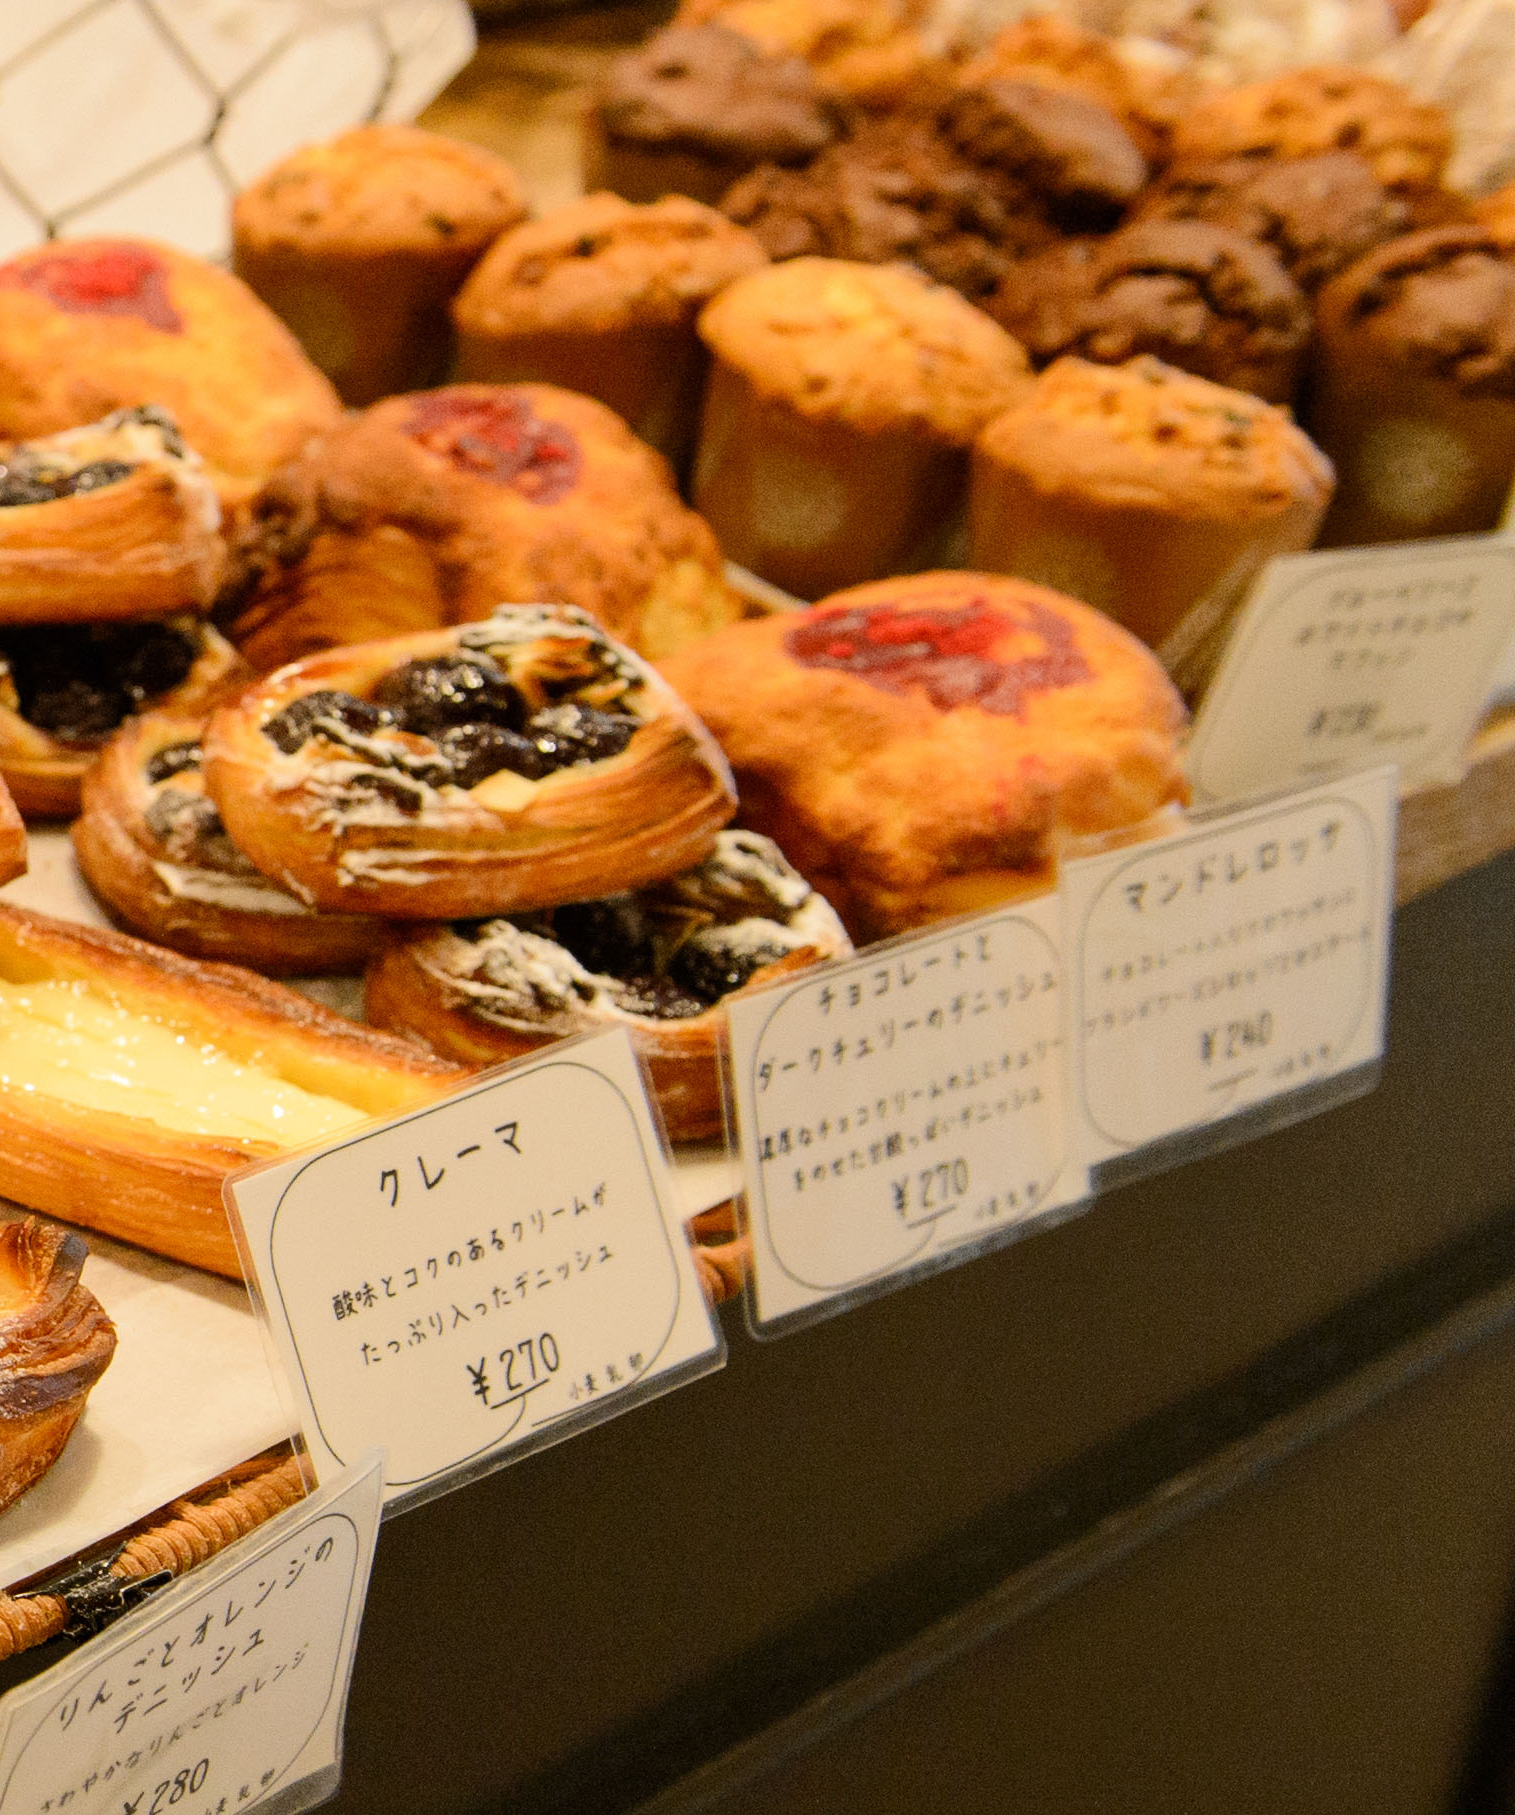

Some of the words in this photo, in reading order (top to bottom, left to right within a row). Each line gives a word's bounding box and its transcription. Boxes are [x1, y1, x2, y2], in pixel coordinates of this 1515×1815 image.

[818, 936, 989, 1014] チョコレートと
[758, 974, 1056, 1091] ダークチェリーのデニッシュ
[380, 1121, 521, 1207] クレーマ
[893, 1159, 966, 1216] ¥270
[332, 1182, 605, 1321] 酸味とコクのあるクリームが
[360, 1245, 613, 1365] たっぷり入ったデニッシュ
[466, 1332, 559, 1405] ¥270
[59, 1537, 334, 1731] りんごとオレンジの
[114, 1629, 264, 1734] デニッシュ
